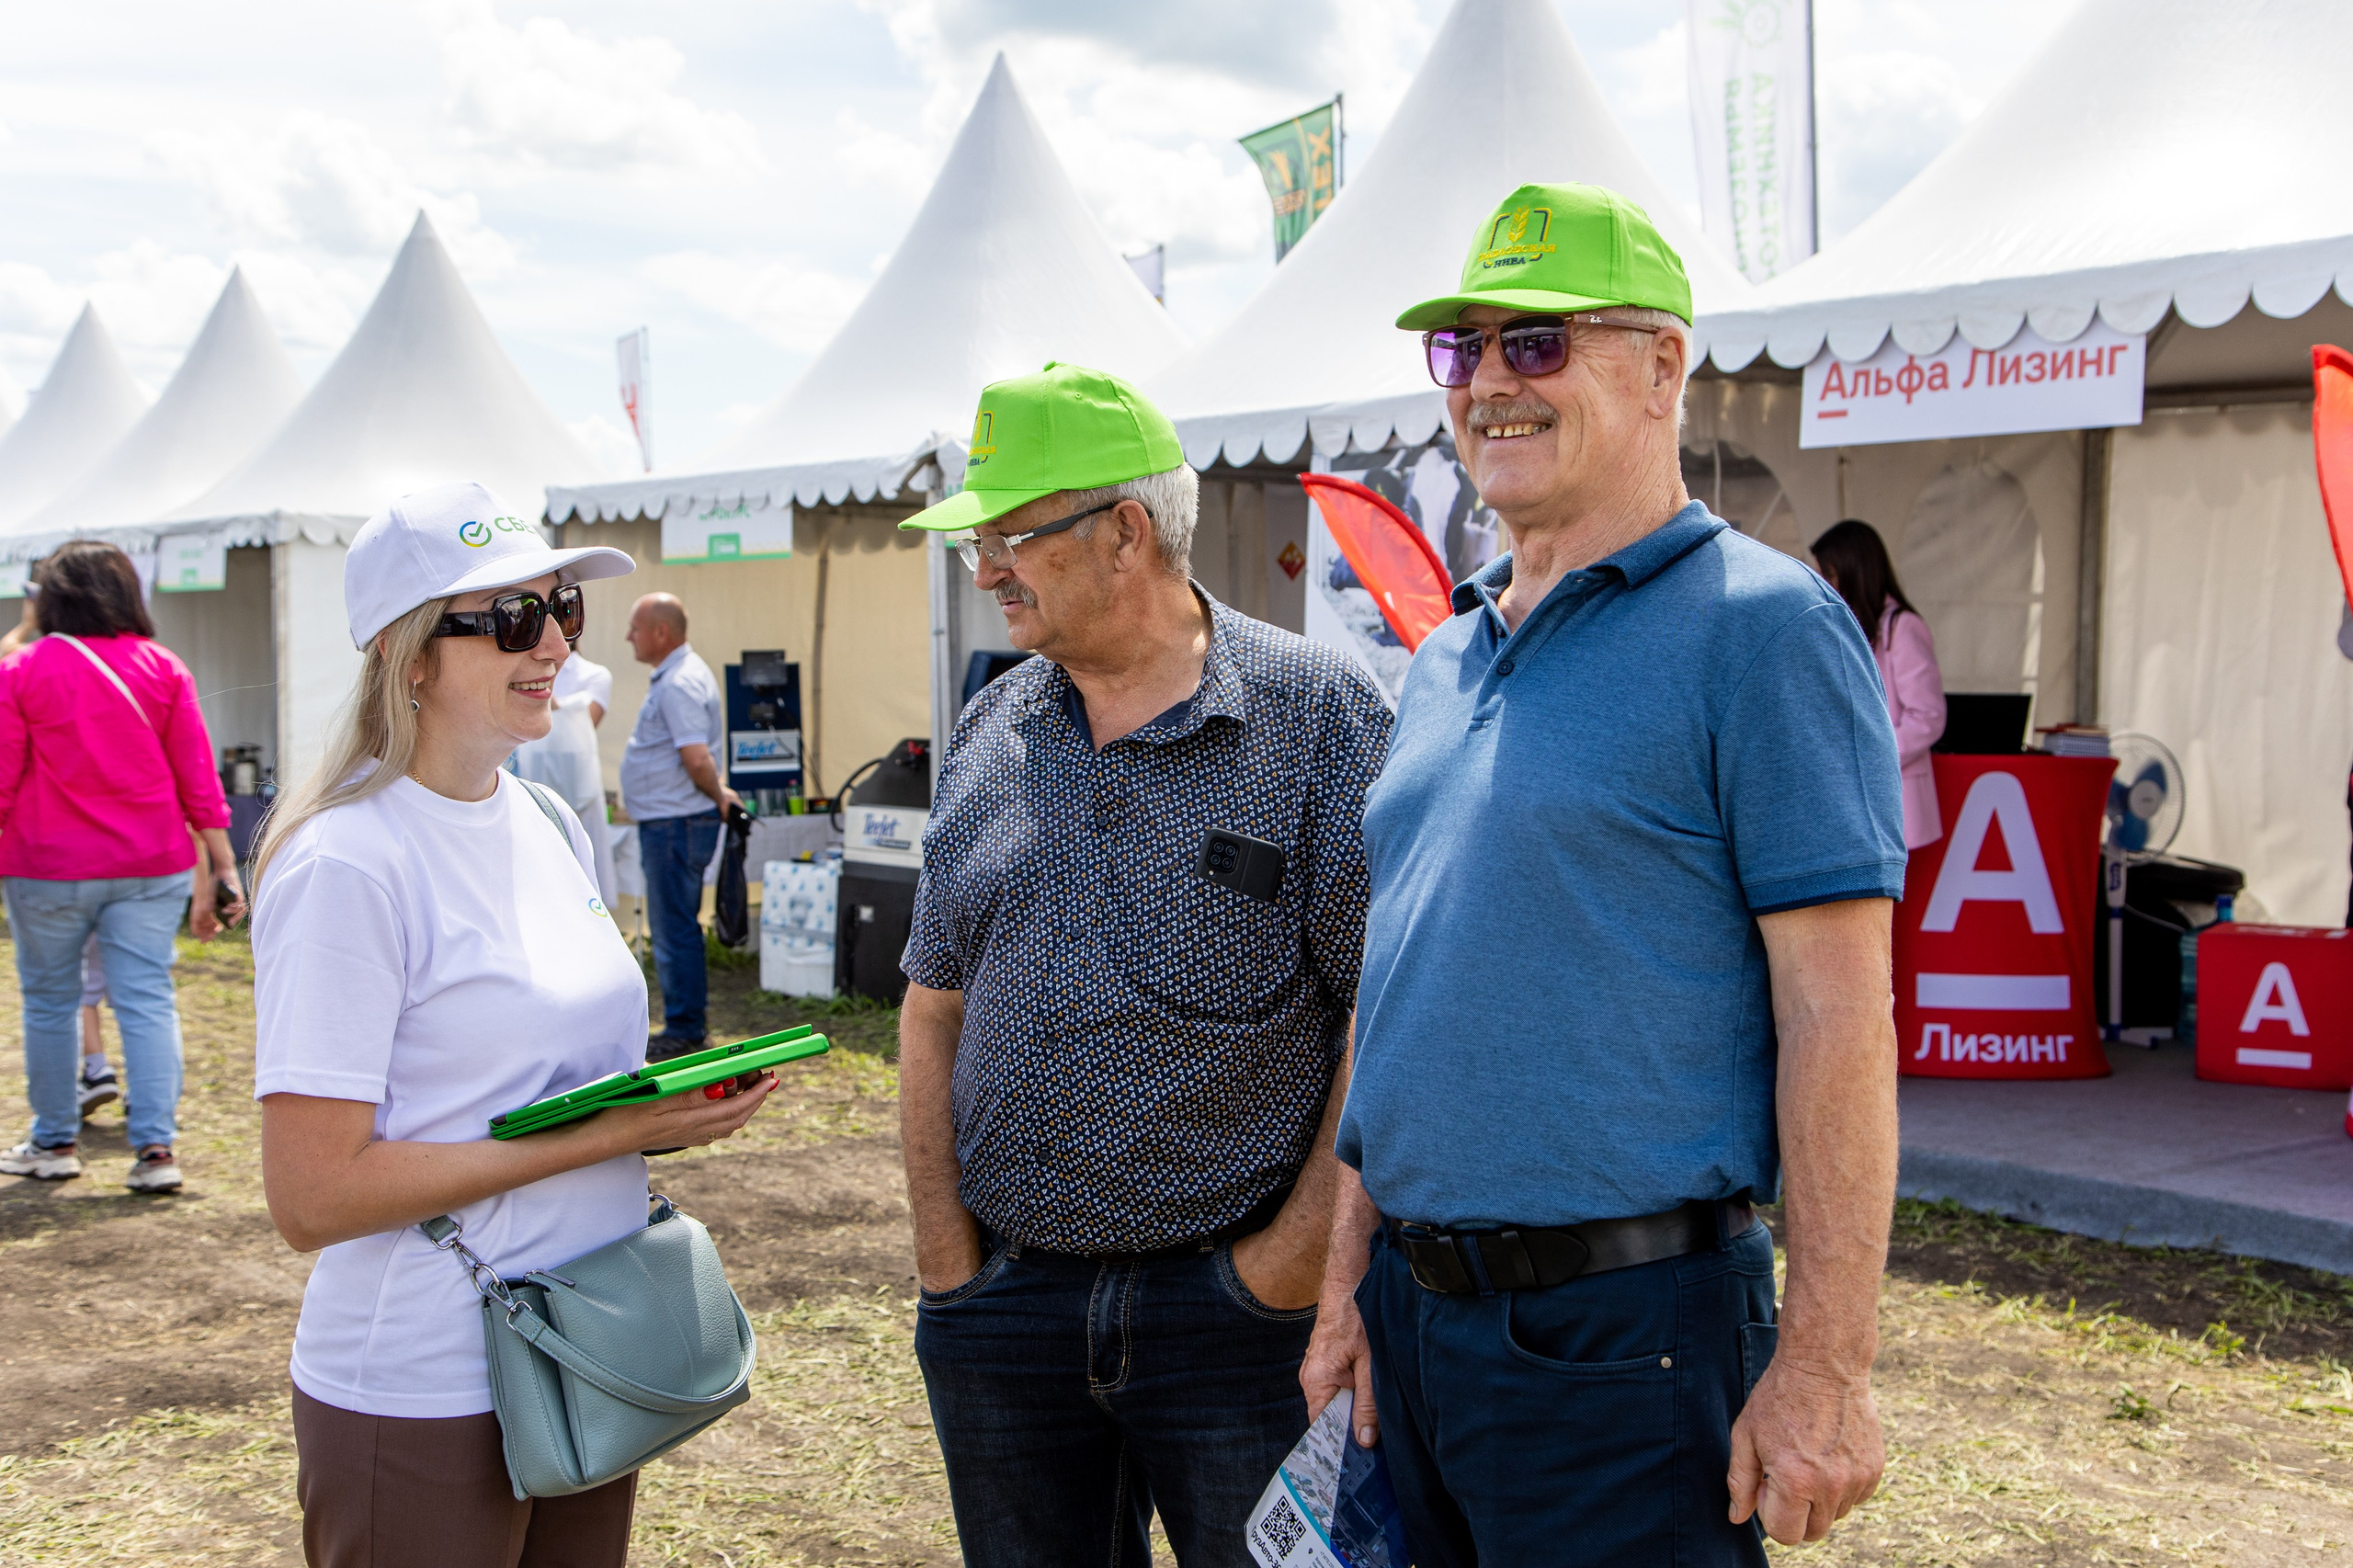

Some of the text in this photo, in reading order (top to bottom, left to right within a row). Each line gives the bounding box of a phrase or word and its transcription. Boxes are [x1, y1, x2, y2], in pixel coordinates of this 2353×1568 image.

[1494, 256, 1526, 268] НИВА
[1820, 344, 2128, 403] Альфа Лизинг
[494, 517, 535, 534] СБЕ
[1921, 771, 2064, 934] А
[2239, 961, 2310, 1037] А
[1915, 1022, 2074, 1062] Лизинг
